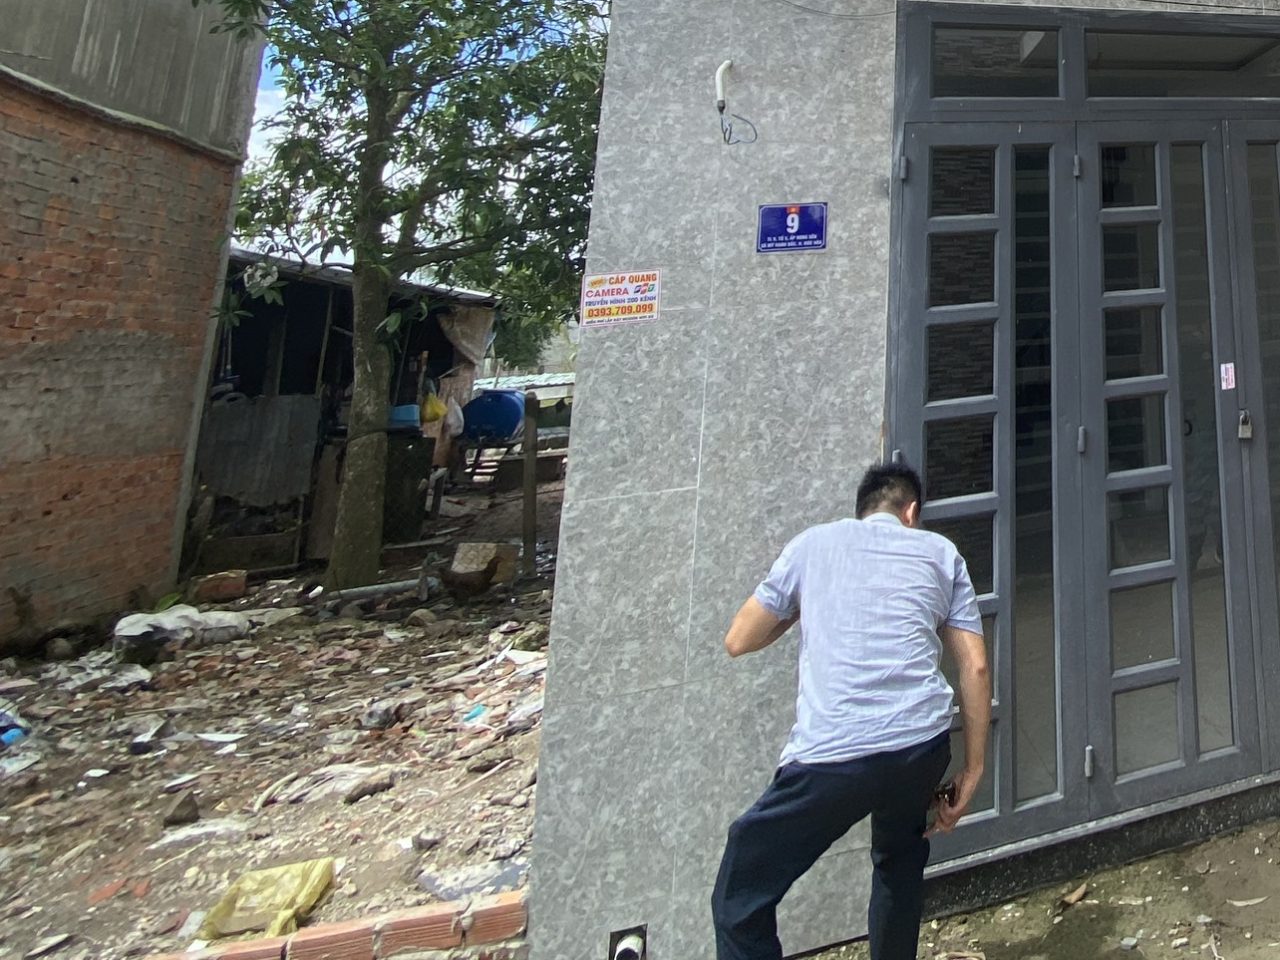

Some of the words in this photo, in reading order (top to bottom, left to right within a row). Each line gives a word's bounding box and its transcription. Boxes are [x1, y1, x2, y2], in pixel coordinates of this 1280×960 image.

[786, 213, 799, 234] 9
[628, 273, 657, 284] QUANG
[585, 287, 629, 298] CAMERA
[588, 303, 654, 318] 0393.709.099
